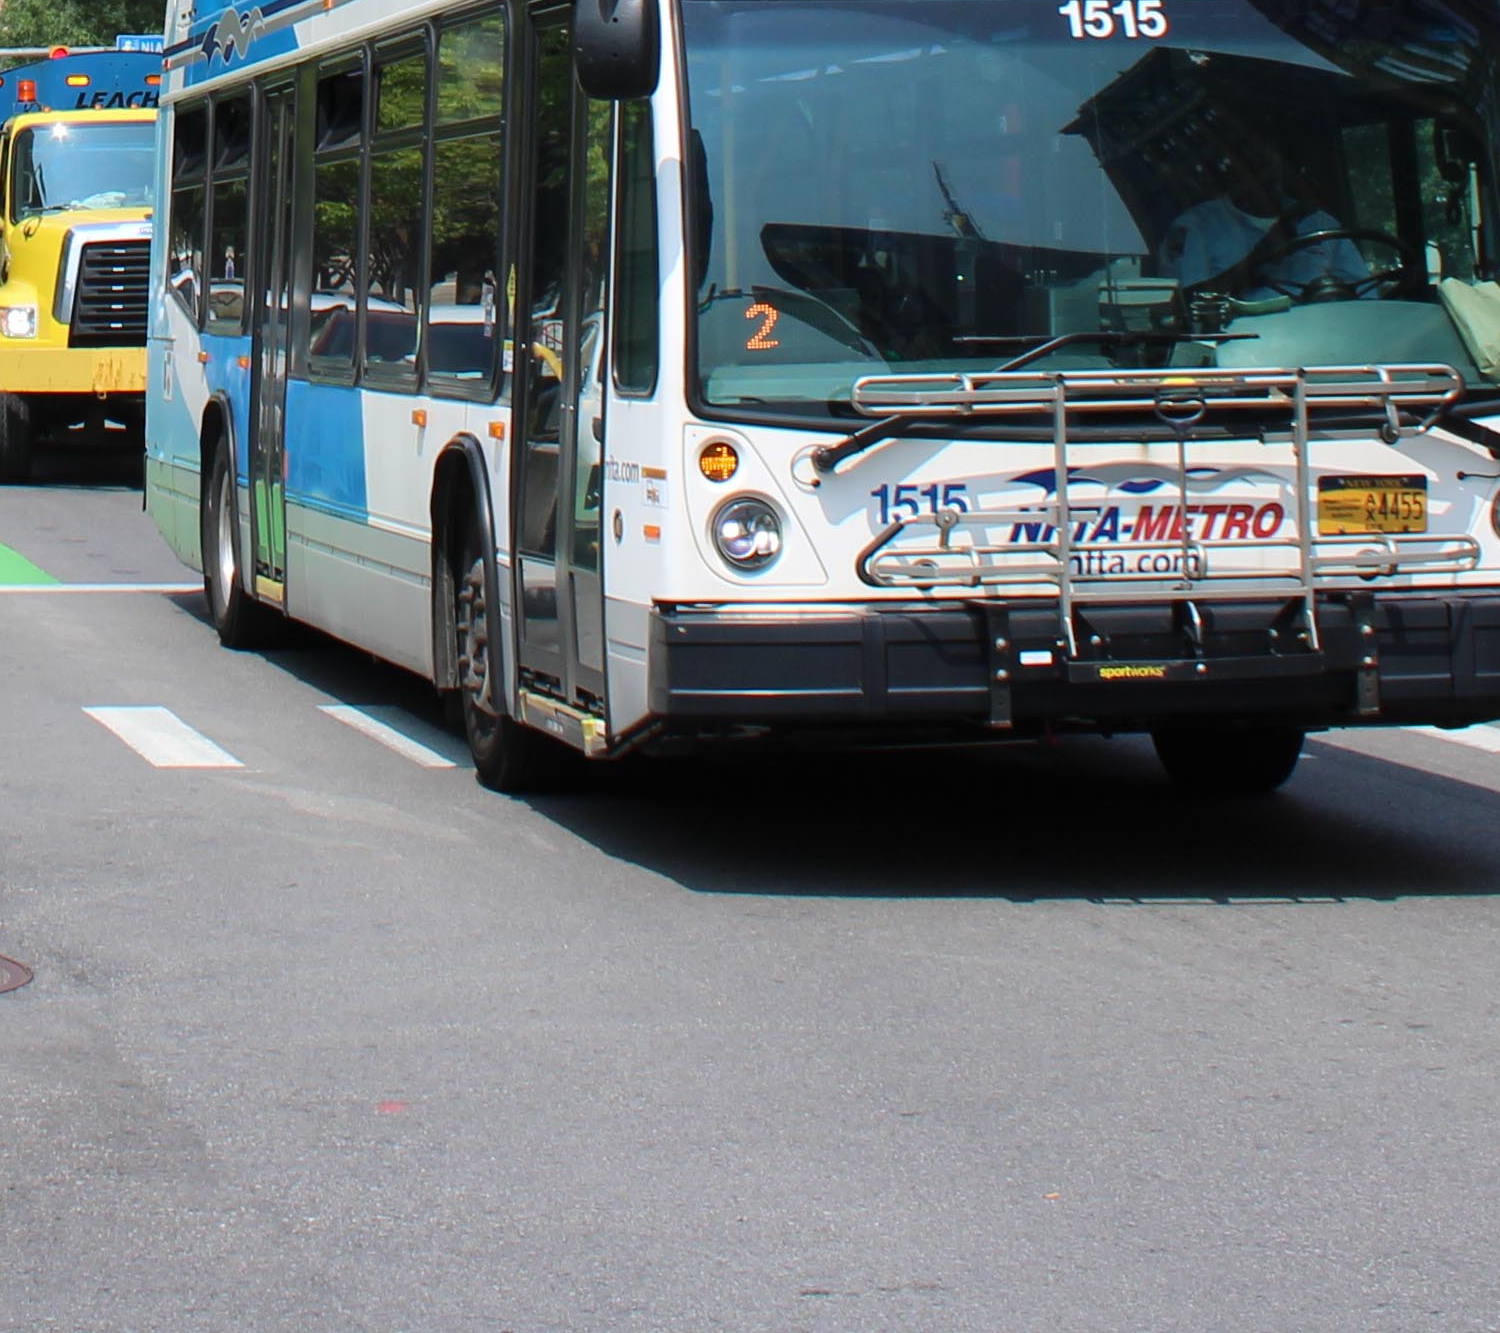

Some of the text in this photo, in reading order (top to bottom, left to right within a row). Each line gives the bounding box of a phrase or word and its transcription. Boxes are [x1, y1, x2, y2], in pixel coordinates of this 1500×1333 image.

[75, 91, 160, 109] LEACH
[745, 304, 779, 349] 2
[870, 483, 968, 524] 1515
[1067, 550, 1200, 575] nfta.com
